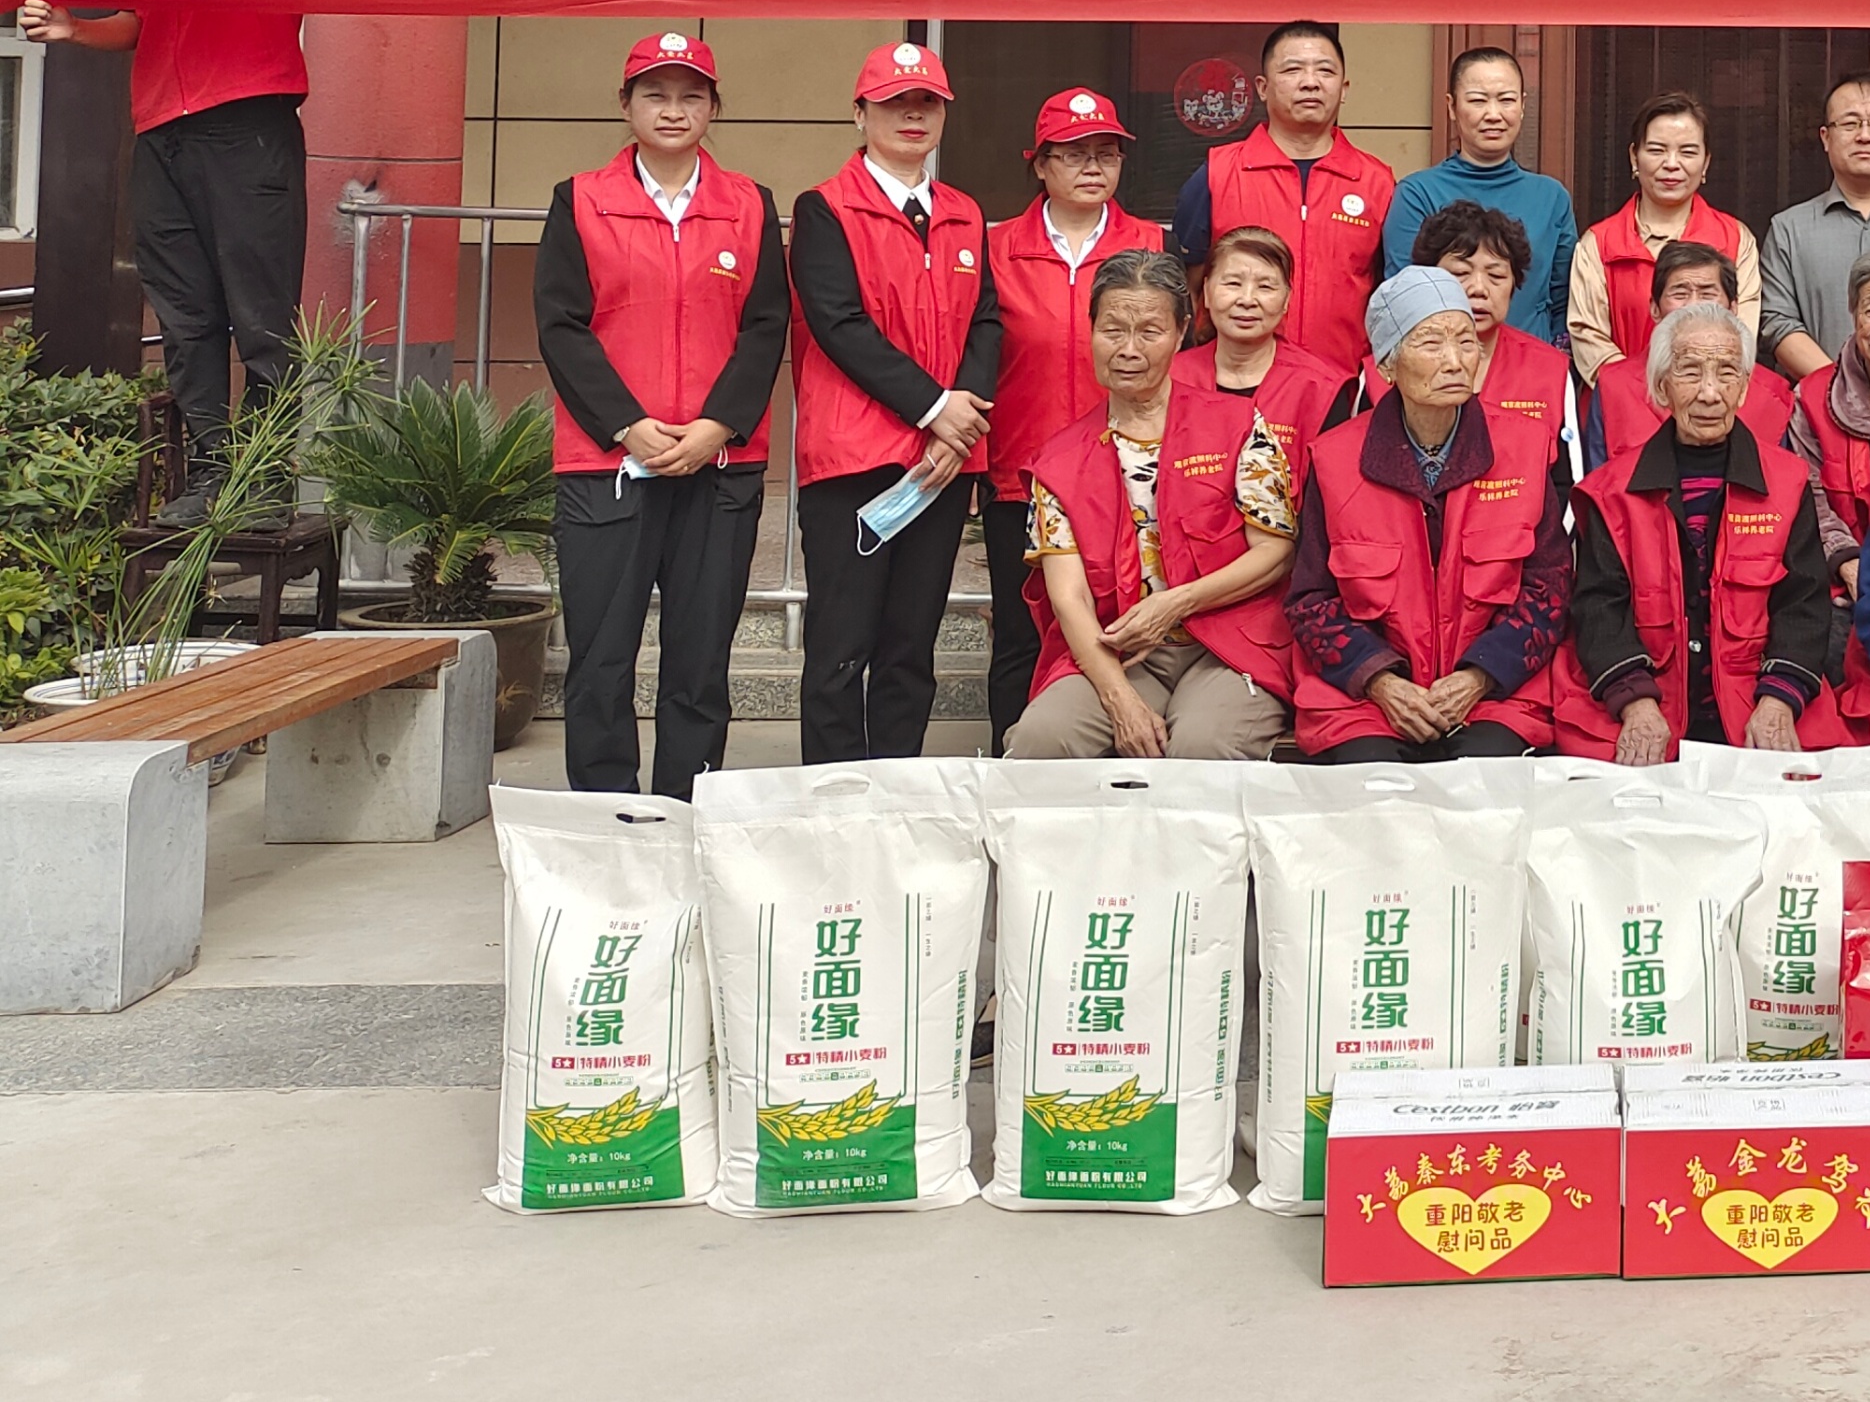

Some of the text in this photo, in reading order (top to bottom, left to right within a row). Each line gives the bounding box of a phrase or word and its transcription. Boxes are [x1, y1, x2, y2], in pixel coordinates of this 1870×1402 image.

[1772, 886, 1819, 994] 好面缘
[811, 918, 862, 1041] 好面缘
[1077, 912, 1135, 1032] 好面缘
[1361, 908, 1410, 1029] 好面缘
[1621, 919, 1667, 1037] 好面缘
[576, 934, 643, 1047] 好面缘
[1775, 1002, 1839, 1016] 特精小麦粉
[816, 1047, 887, 1064] 特精小麦粉
[1082, 1042, 1150, 1056] 特精小麦粉
[1366, 1037, 1434, 1054] 特精小麦粉
[1626, 1042, 1692, 1059] 特精小麦粉
[579, 1053, 651, 1070] 特精小麦粉
[1425, 1200, 1526, 1227] 重阳敬老
[1725, 1202, 1816, 1225] 重阳敬老
[1437, 1227, 1513, 1254] 慰问品
[1737, 1227, 1804, 1249] 慰问品
